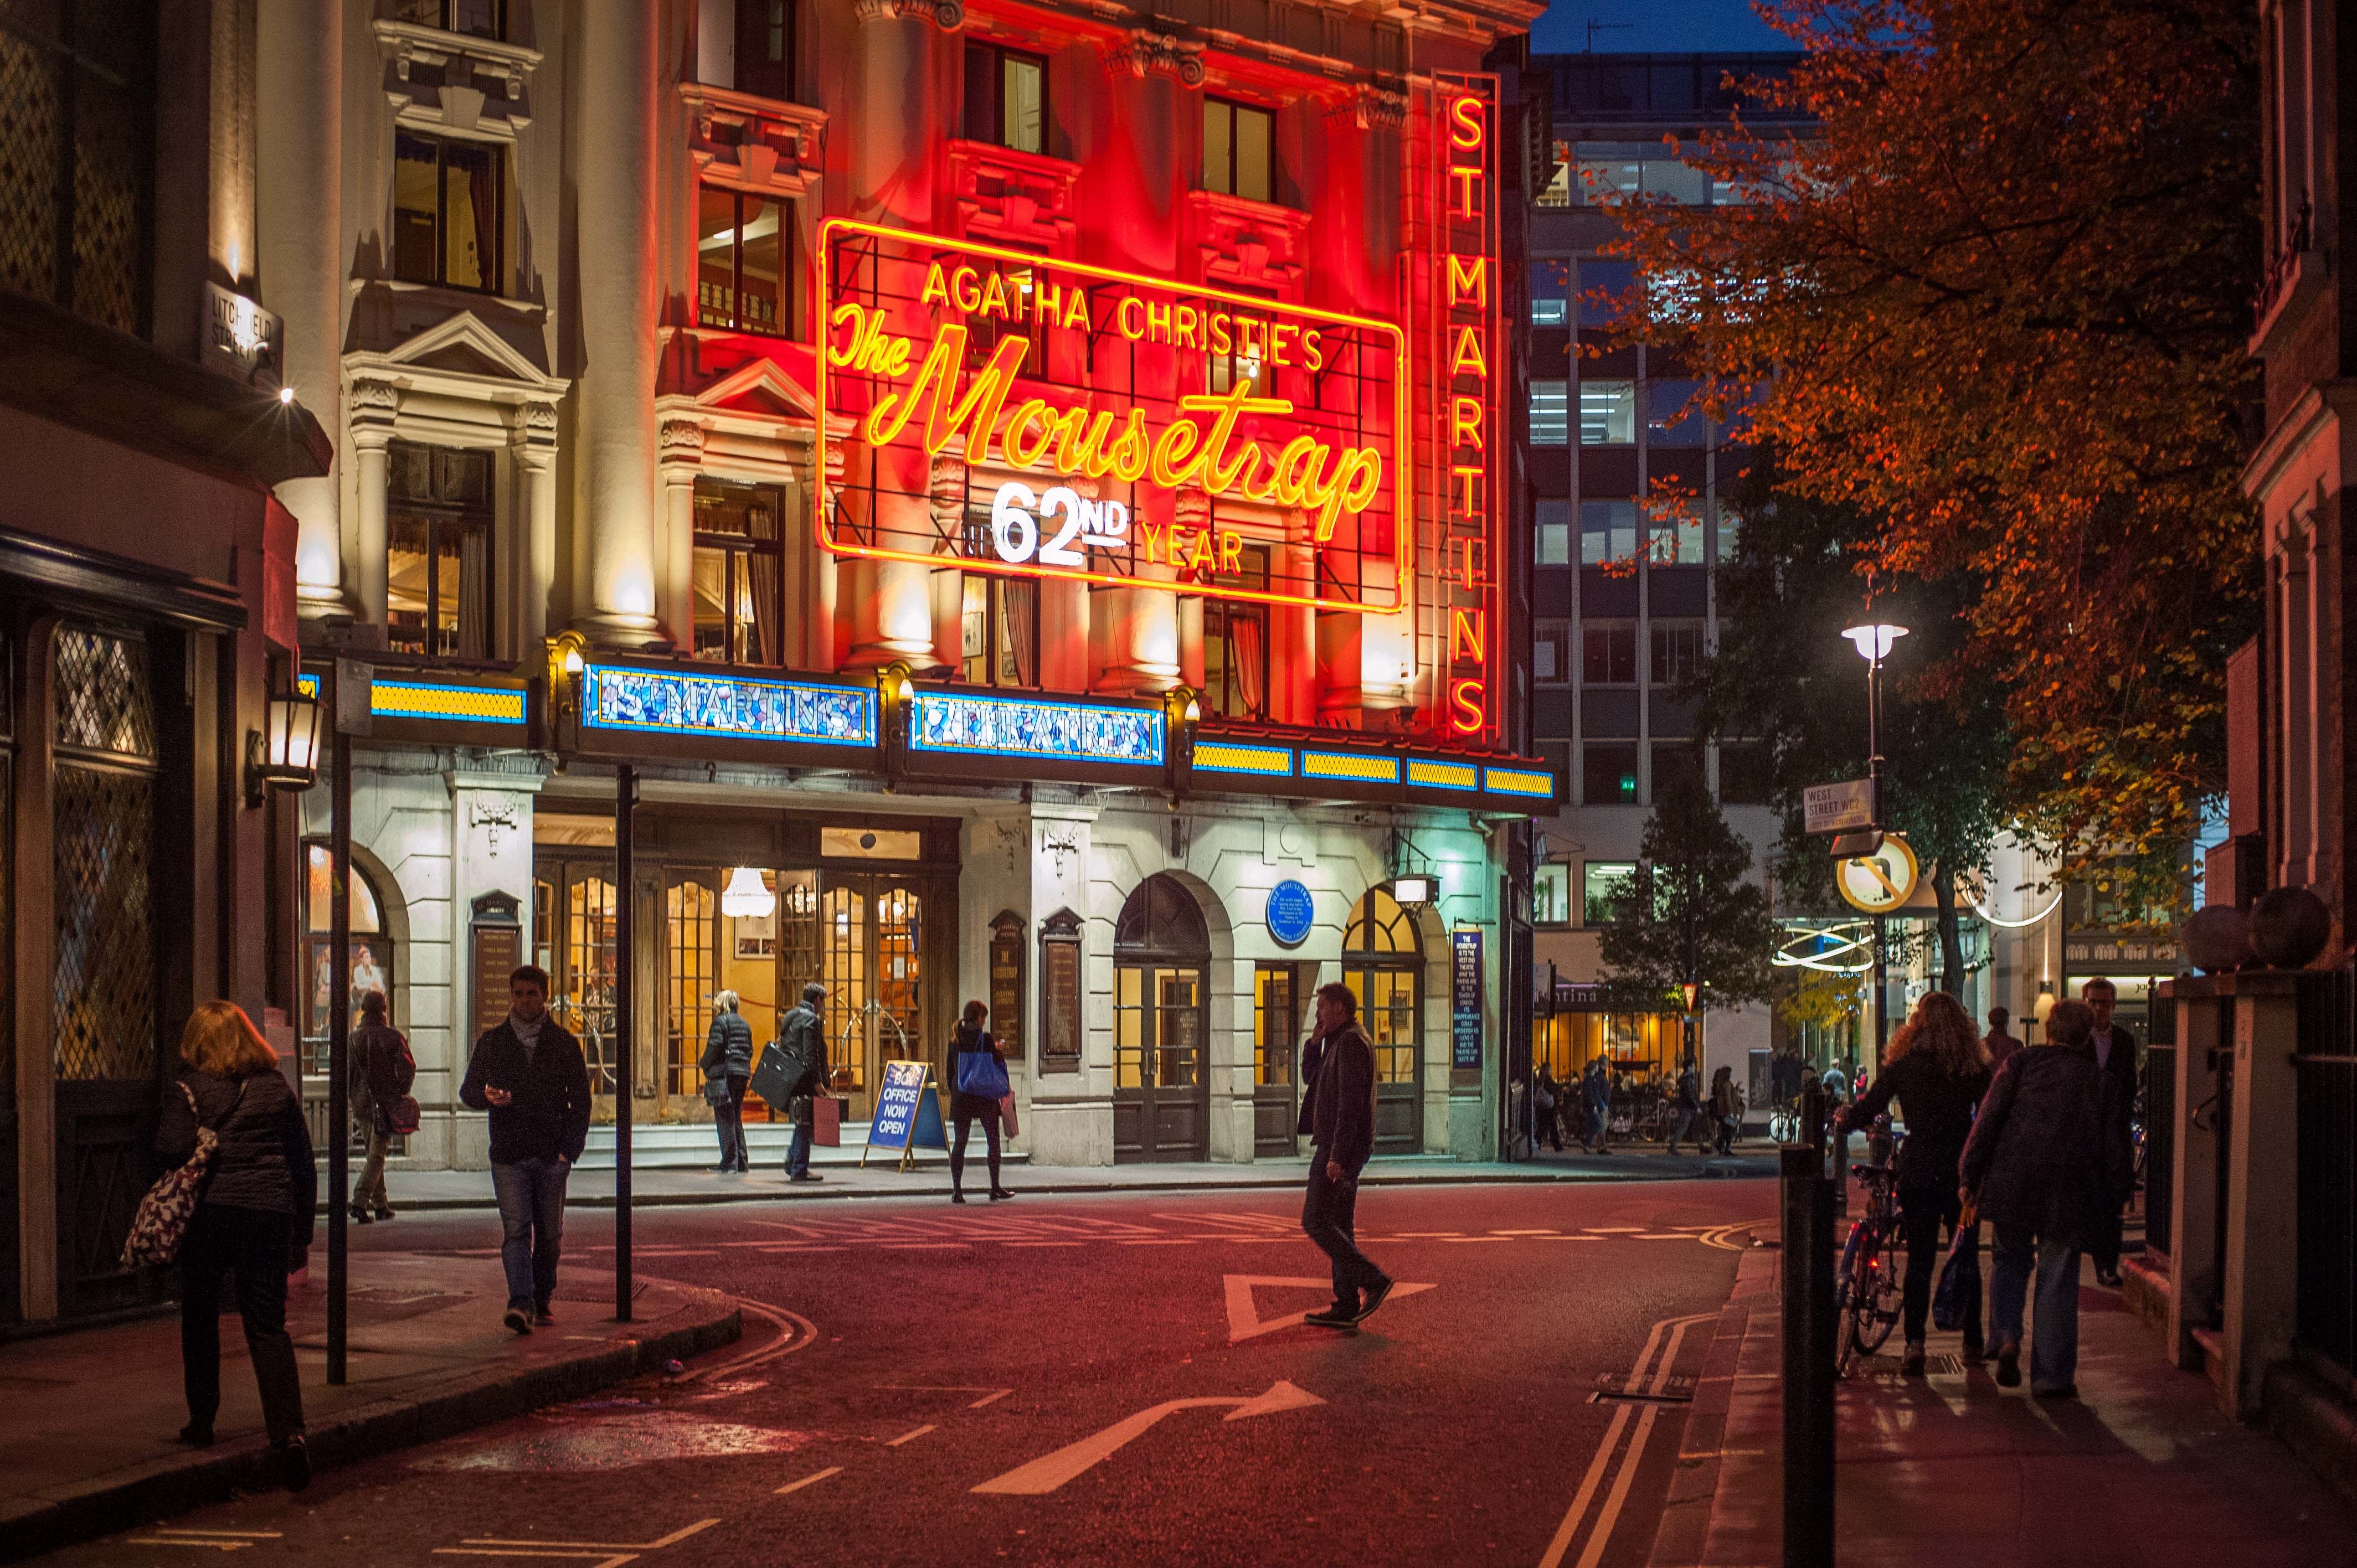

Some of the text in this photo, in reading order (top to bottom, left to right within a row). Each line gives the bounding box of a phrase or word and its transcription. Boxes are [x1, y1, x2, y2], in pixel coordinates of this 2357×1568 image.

[921, 262, 1322, 373] AGATHA CHRISTIE'S
[828, 303, 1382, 542] The Mousetrap
[1140, 522, 1243, 577] YEAR
[1808, 788, 1831, 802] WEST
[1808, 798, 1860, 817] STREET WC2
[893, 1071, 914, 1087] BOX
[883, 1087, 918, 1103] OFFICE
[884, 1104, 908, 1119] NOW
[878, 1120, 905, 1136] OPEN
